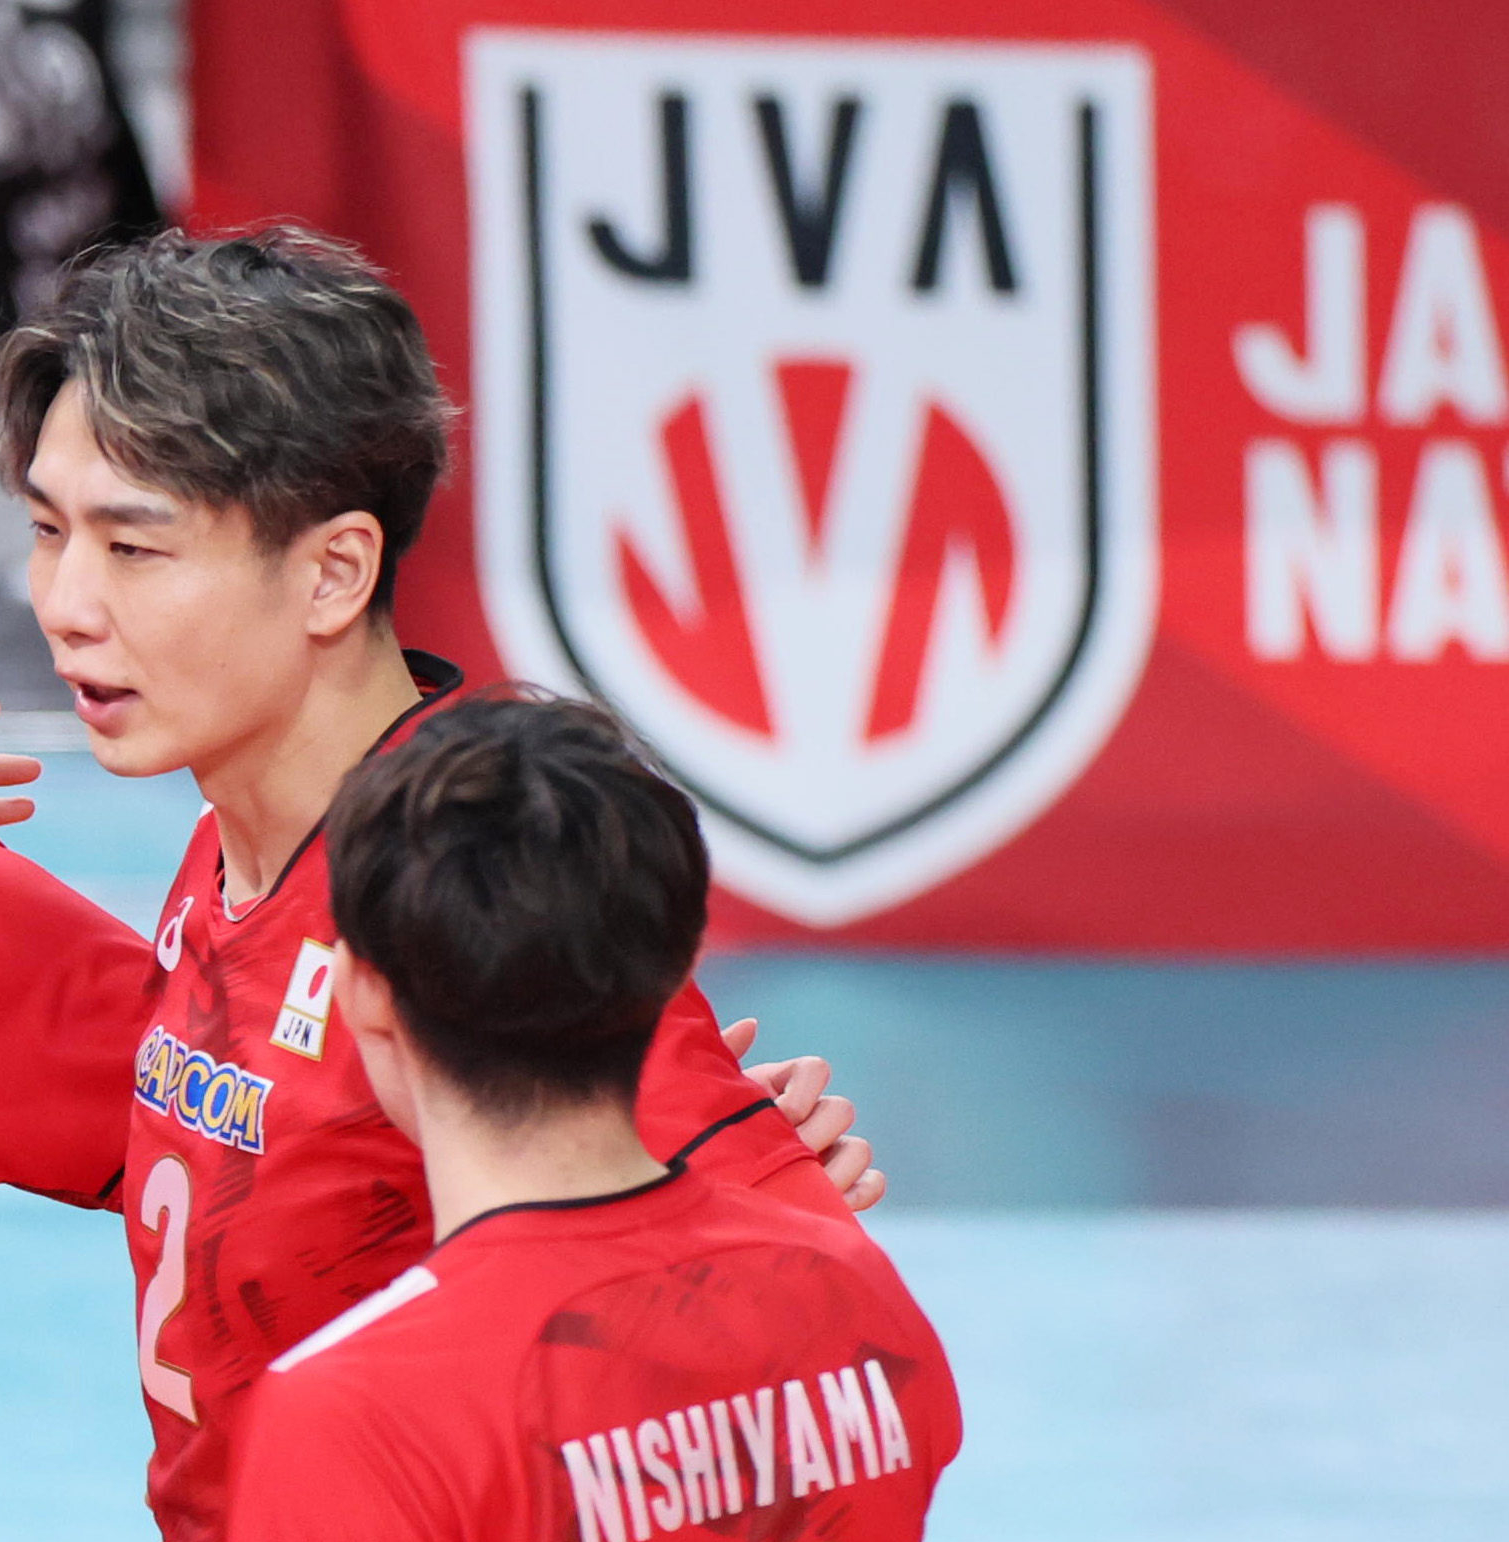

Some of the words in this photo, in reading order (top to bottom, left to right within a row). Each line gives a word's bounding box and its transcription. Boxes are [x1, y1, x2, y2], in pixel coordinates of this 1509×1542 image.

[586, 88, 1023, 294] JVA
[1243, 437, 1508, 662] NA
[139, 1153, 200, 1426] 2
